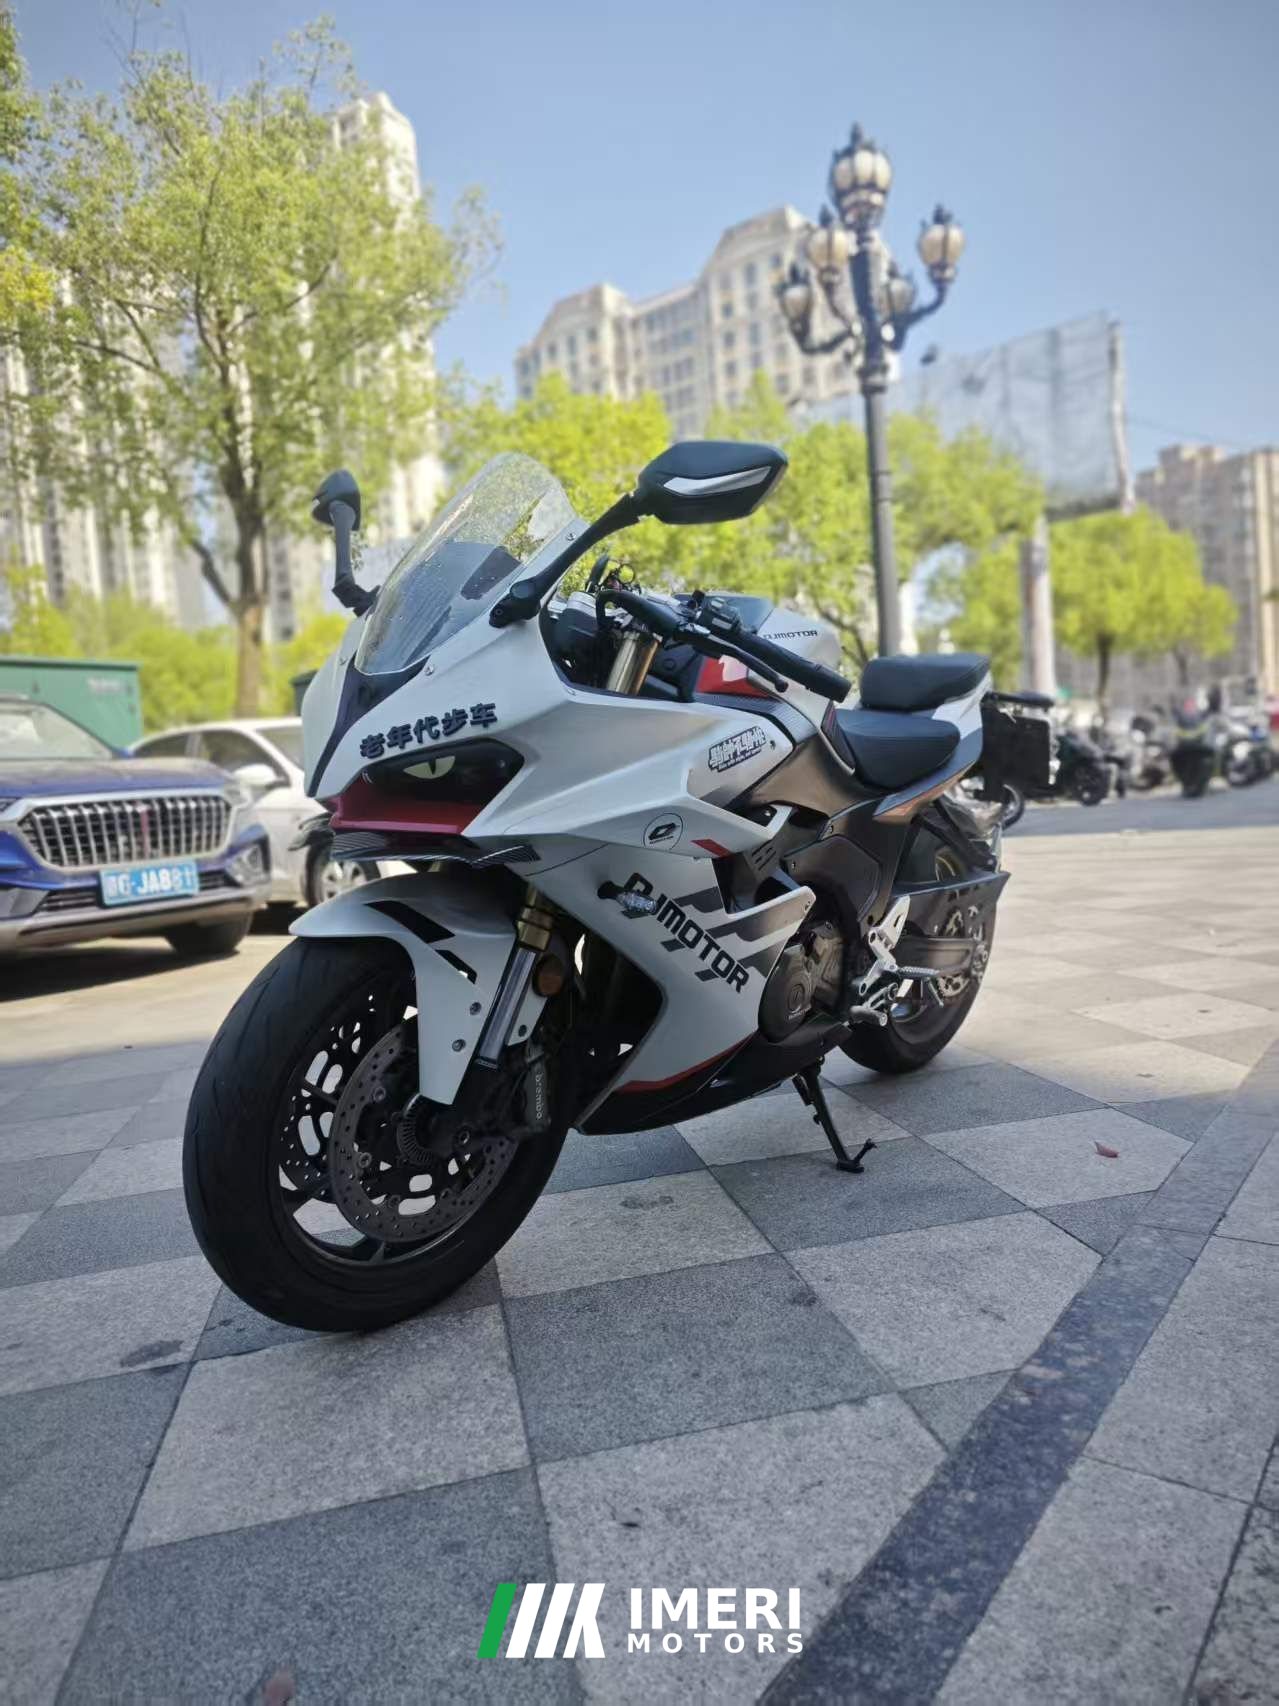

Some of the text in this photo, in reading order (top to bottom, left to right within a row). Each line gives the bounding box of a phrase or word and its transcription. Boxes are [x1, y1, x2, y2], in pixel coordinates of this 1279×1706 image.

[360, 703, 498, 759] 老年代步车
